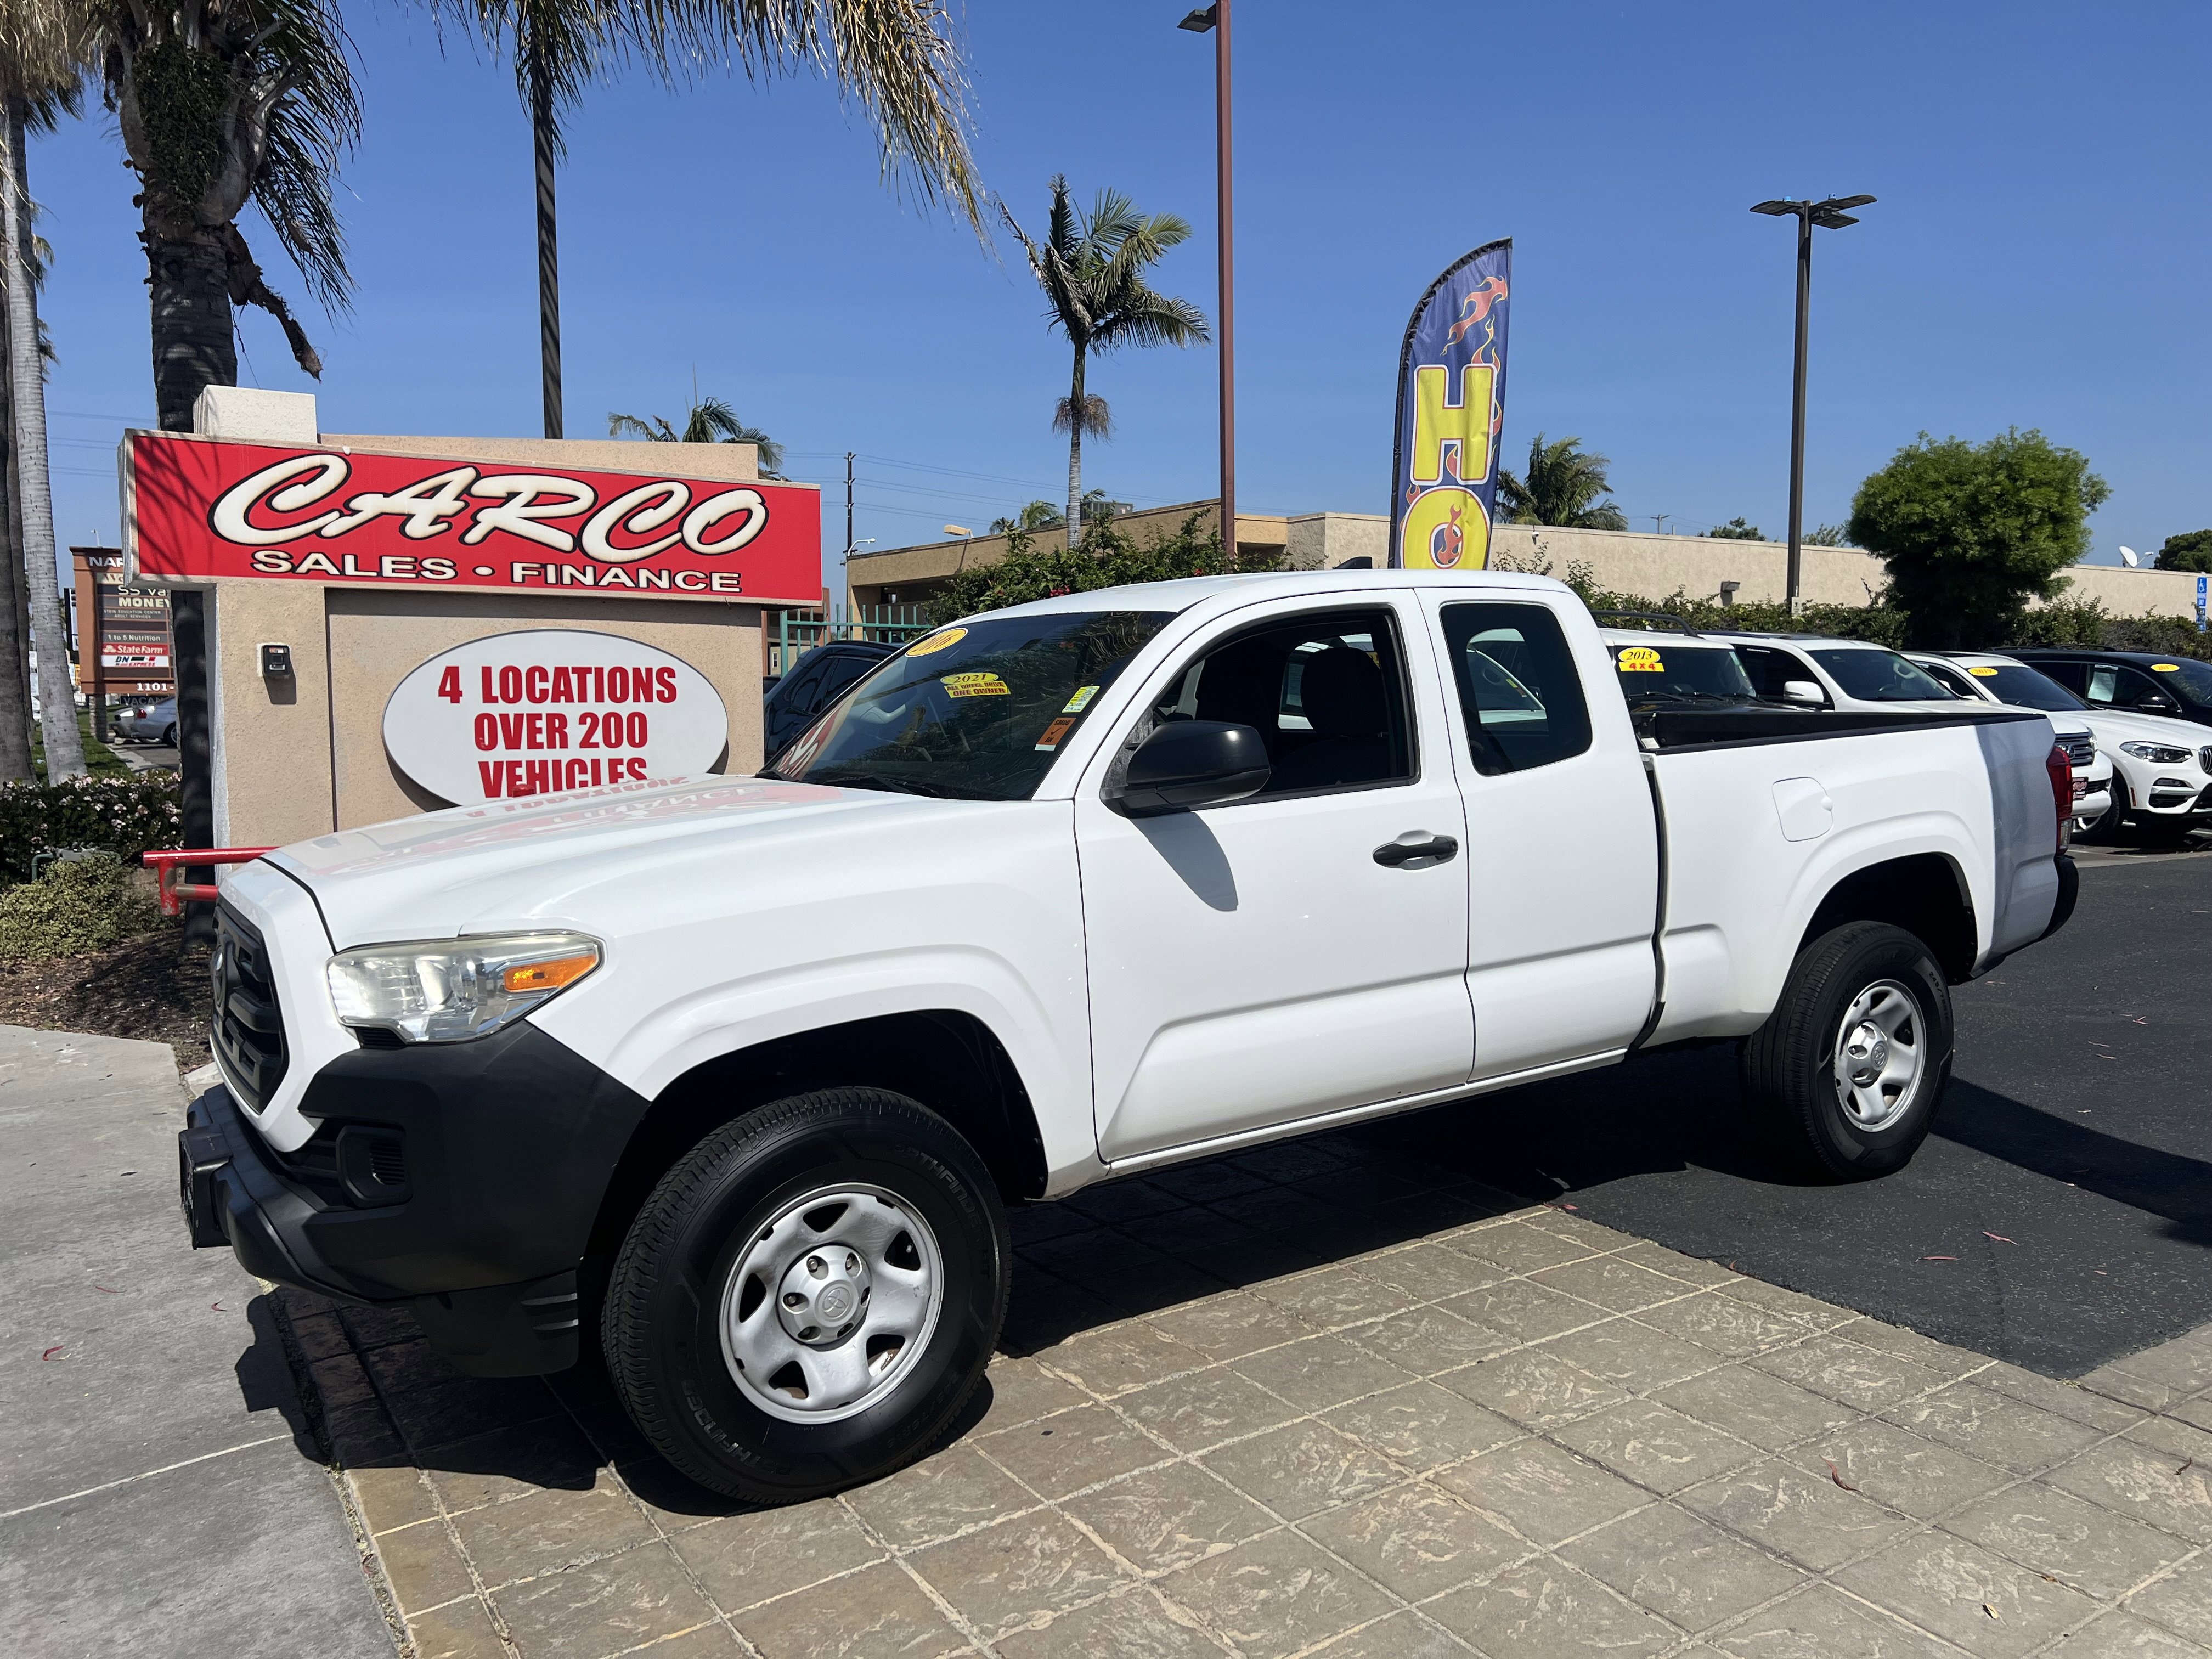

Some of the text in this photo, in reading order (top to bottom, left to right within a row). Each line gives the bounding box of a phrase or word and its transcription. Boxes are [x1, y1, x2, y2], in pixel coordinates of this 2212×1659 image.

[208, 454, 768, 563] CARCO
[251, 548, 742, 592] SALES FINANCE
[1626, 651, 1653, 660] 2013
[438, 665, 678, 704] 4 LOCATIONS
[953, 674, 986, 684] 2021
[474, 711, 648, 752] OVER 200
[478, 757, 648, 798] VEHICLES
